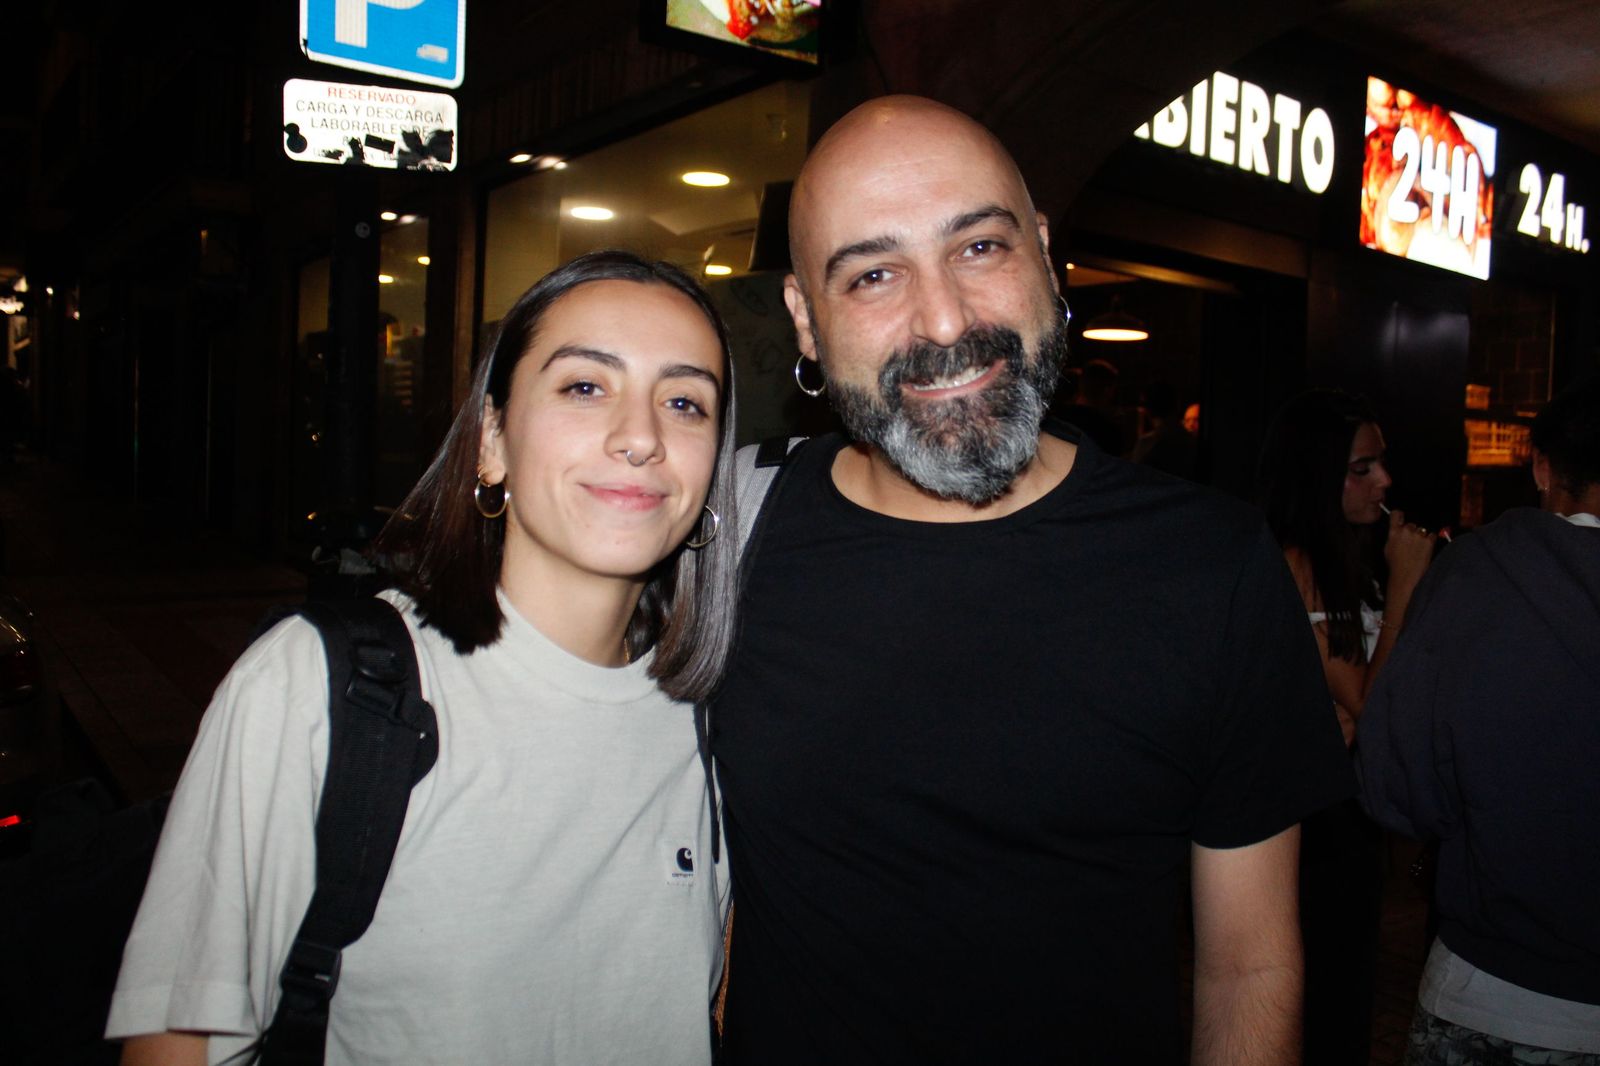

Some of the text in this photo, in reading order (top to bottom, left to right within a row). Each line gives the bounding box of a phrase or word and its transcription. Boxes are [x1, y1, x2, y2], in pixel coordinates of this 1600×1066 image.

[295, 99, 444, 124] CARGA Y DESCARGA
[327, 86, 417, 106] RESERVADO
[1133, 70, 1335, 194] BIERTO
[1387, 125, 1480, 245] 24H
